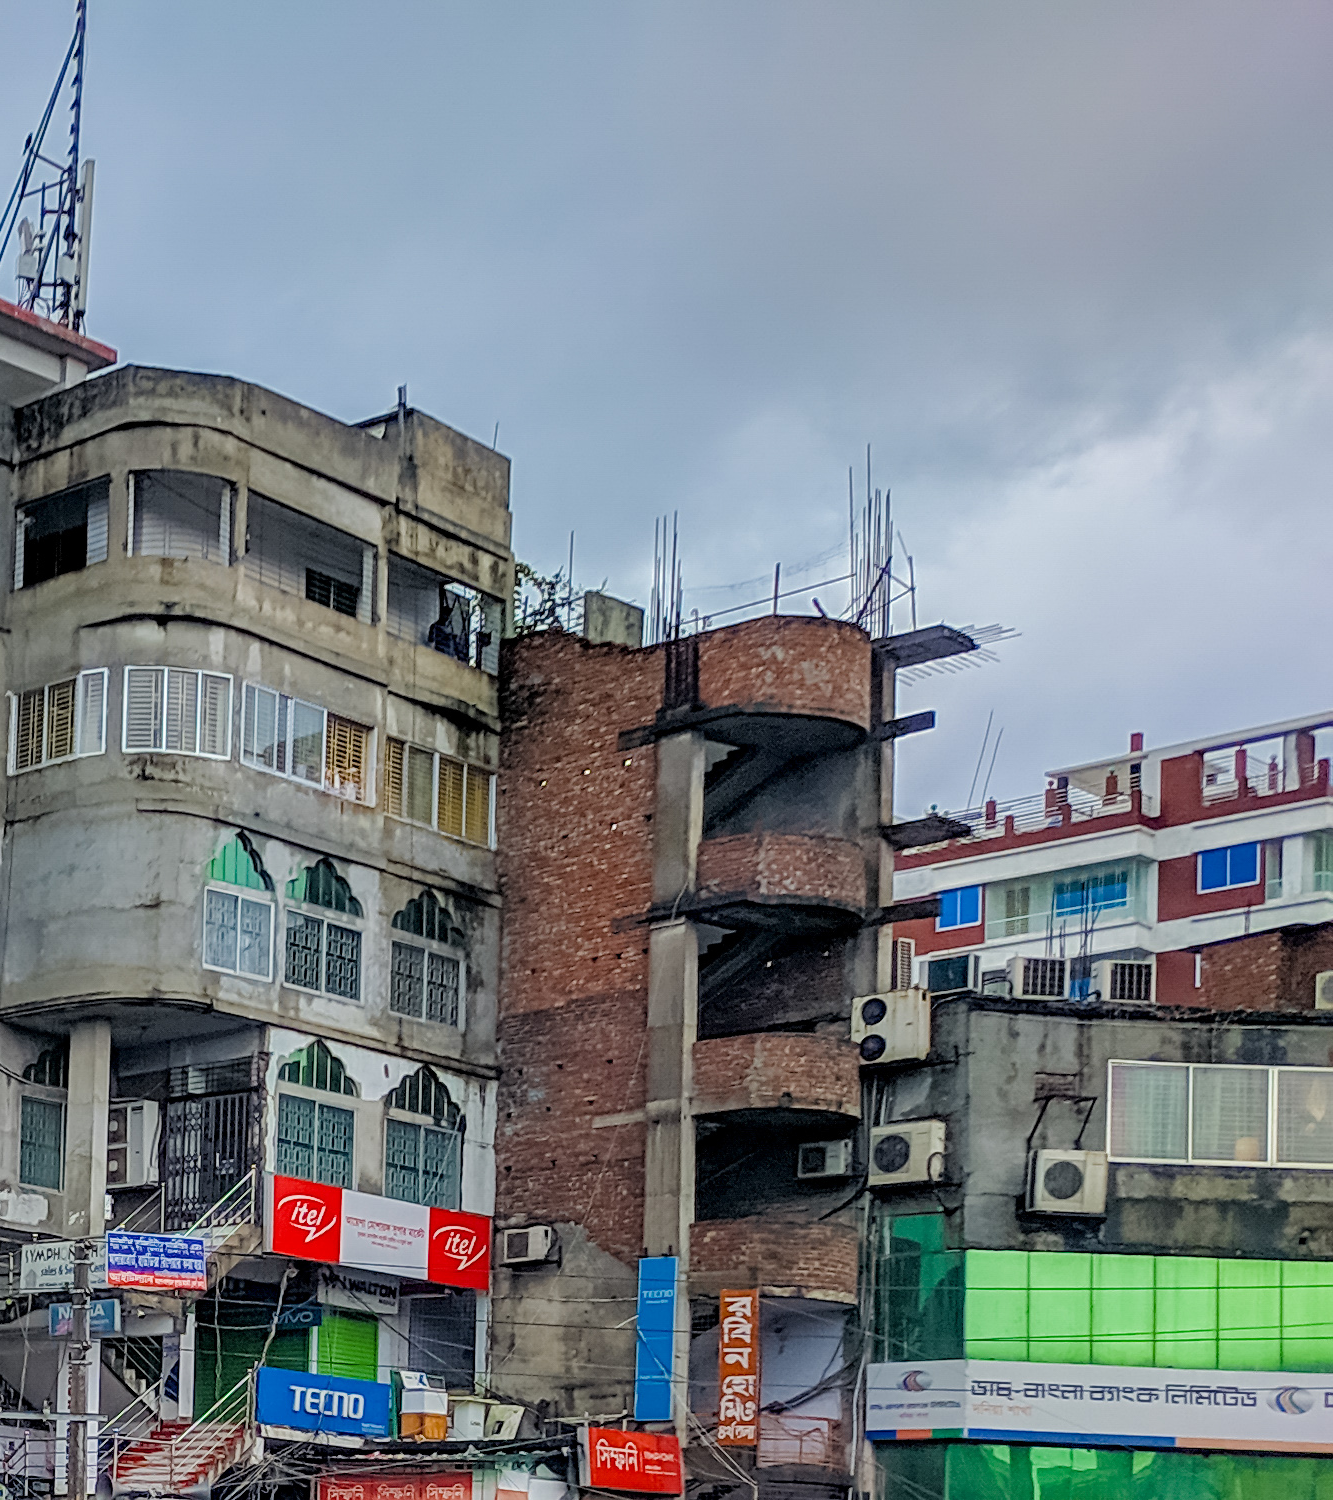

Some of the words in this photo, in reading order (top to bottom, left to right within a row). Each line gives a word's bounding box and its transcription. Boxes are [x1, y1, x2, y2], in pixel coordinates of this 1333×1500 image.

[291, 1201, 326, 1226] itel
[25, 1244, 76, 1263] SYMPHON
[444, 1231, 477, 1255] itel
[349, 1277, 398, 1299] WALTON
[642, 1289, 674, 1299] TECNO
[290, 1385, 365, 1420] TECNO
[971, 1380, 1084, 1401] ডাচ্-বাংলা
[1089, 1385, 1160, 1403] ব্যাংক
[1165, 1384, 1257, 1407] লিমিটেড
[596, 1438, 639, 1473] সিম্ফনি
[426, 1483, 466, 1500] সিম্ফনি
